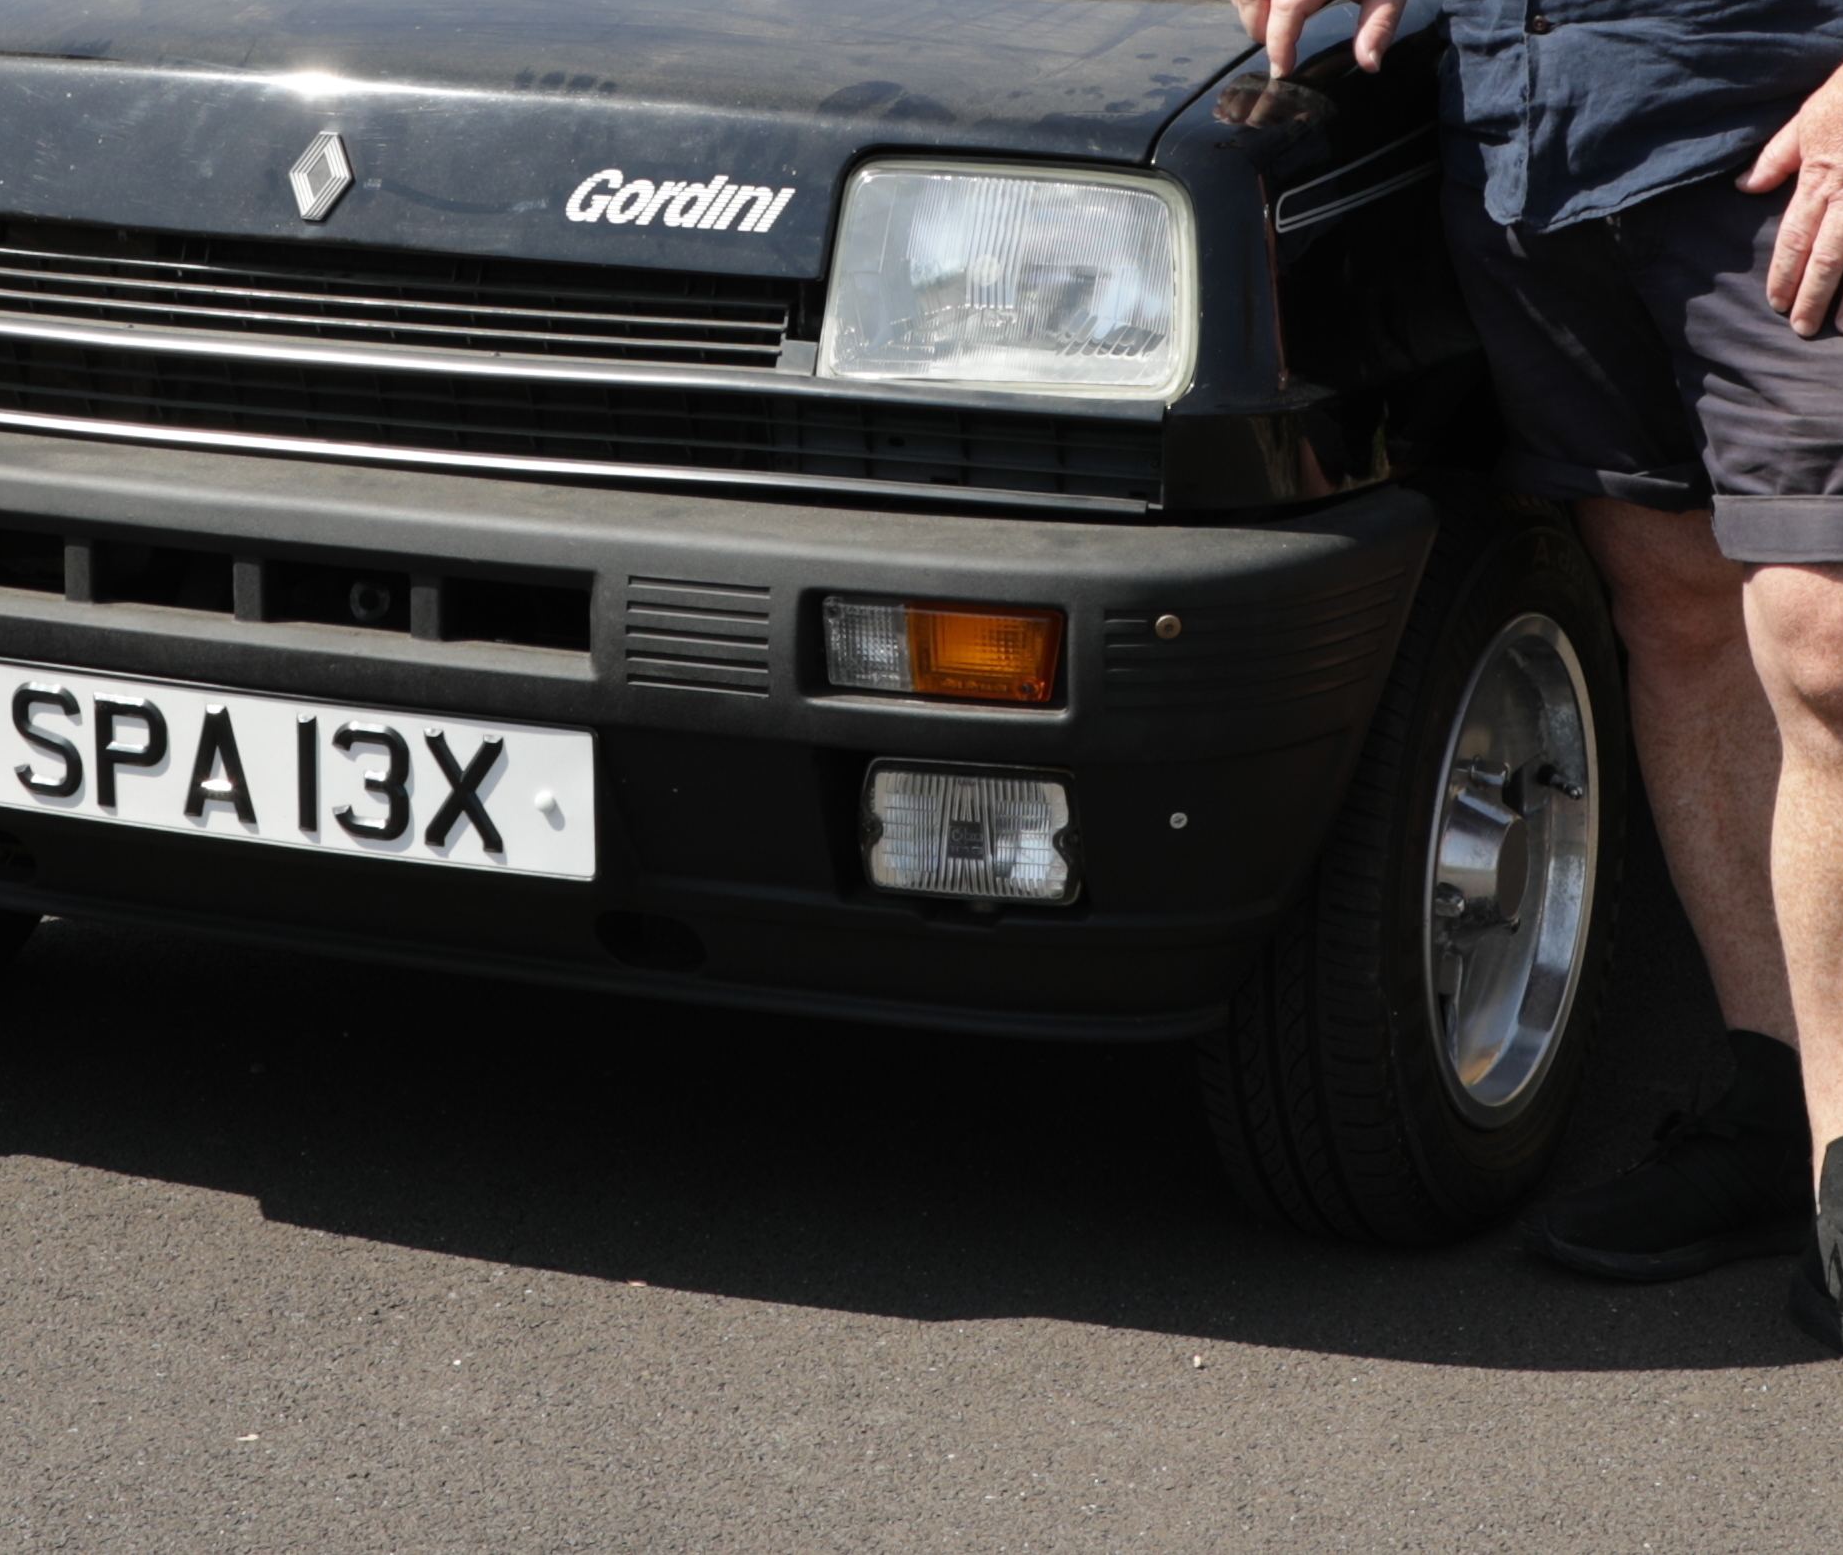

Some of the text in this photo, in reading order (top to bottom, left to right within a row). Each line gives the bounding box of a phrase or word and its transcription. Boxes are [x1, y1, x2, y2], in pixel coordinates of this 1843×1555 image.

[565, 168, 796, 233] Gordini
[12, 681, 505, 854] SPA 13X
